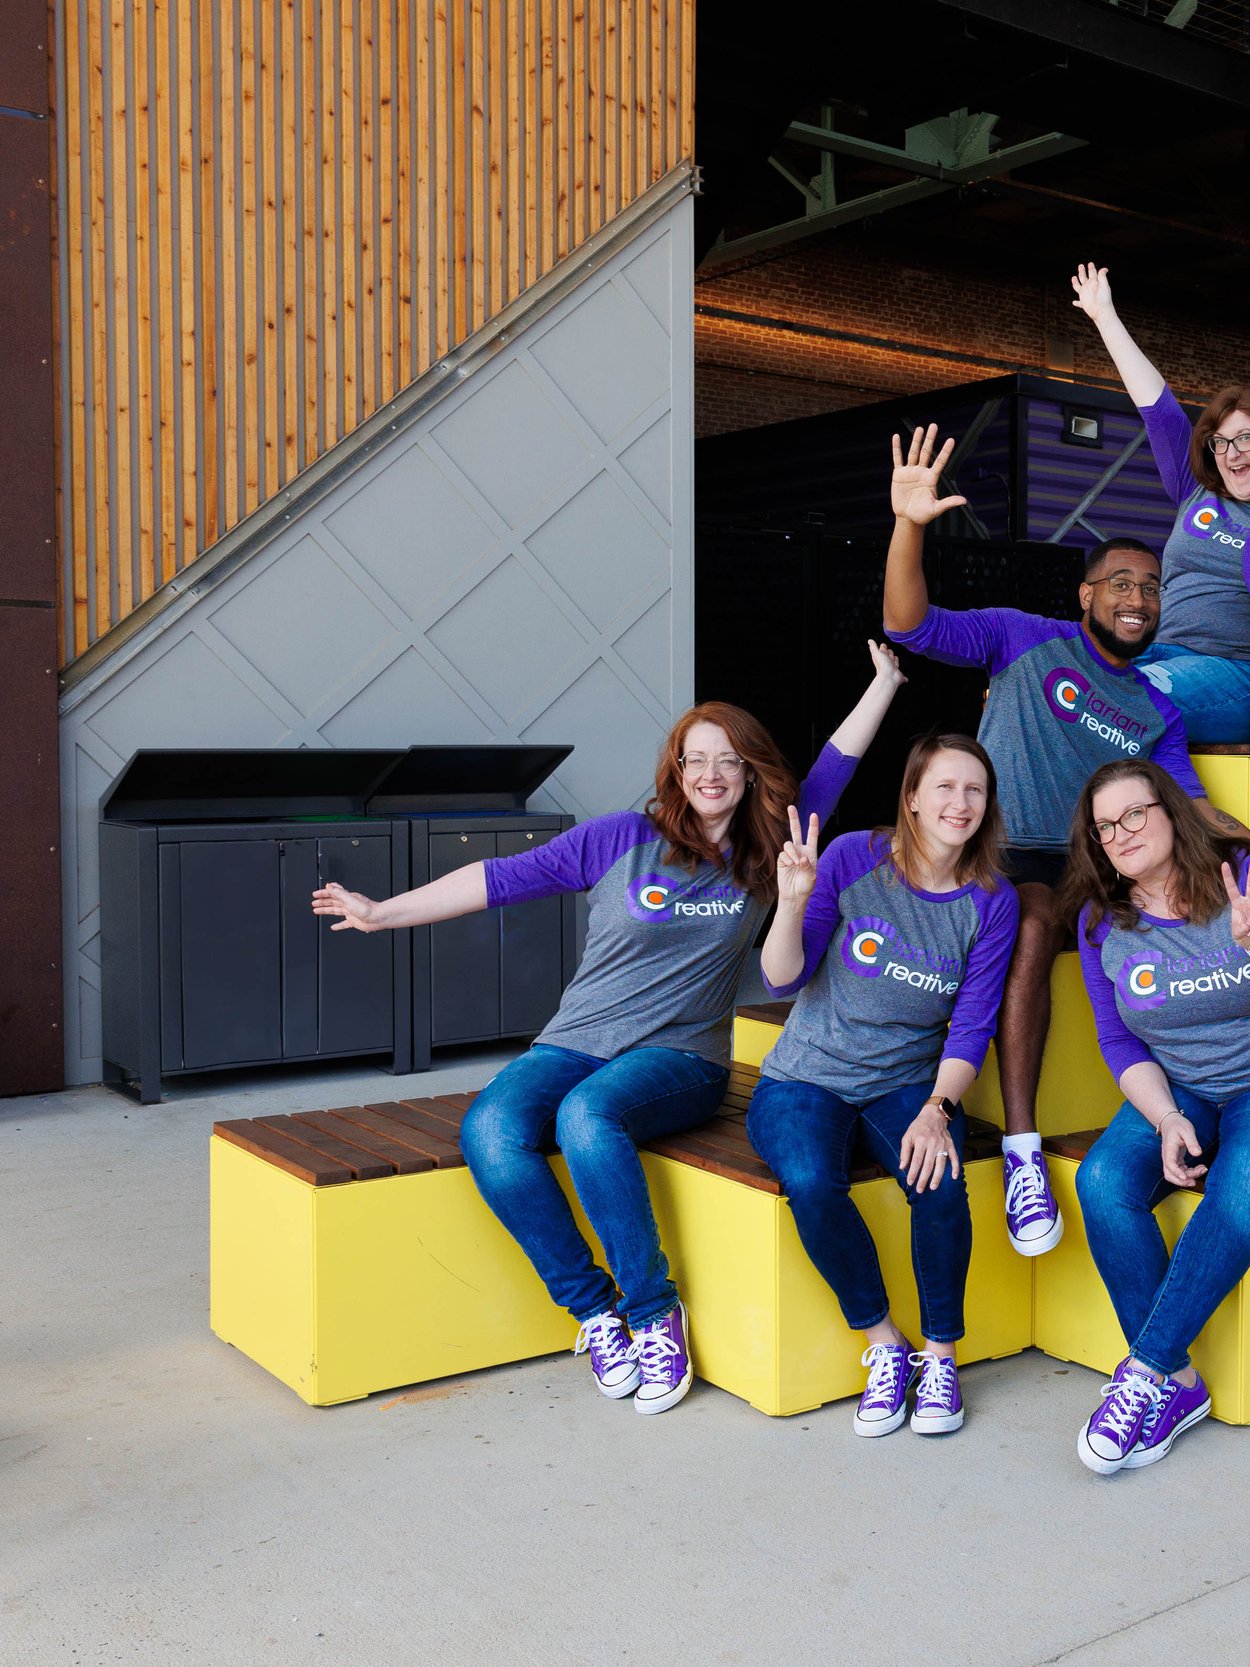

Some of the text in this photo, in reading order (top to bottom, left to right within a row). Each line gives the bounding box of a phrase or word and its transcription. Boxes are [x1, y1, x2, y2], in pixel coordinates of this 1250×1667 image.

[1043, 667, 1148, 739] Clariant
[1056, 681, 1140, 756] Creative
[640, 885, 744, 916] Creative
[852, 931, 959, 995] Creative
[1116, 945, 1247, 1012] Clarian
